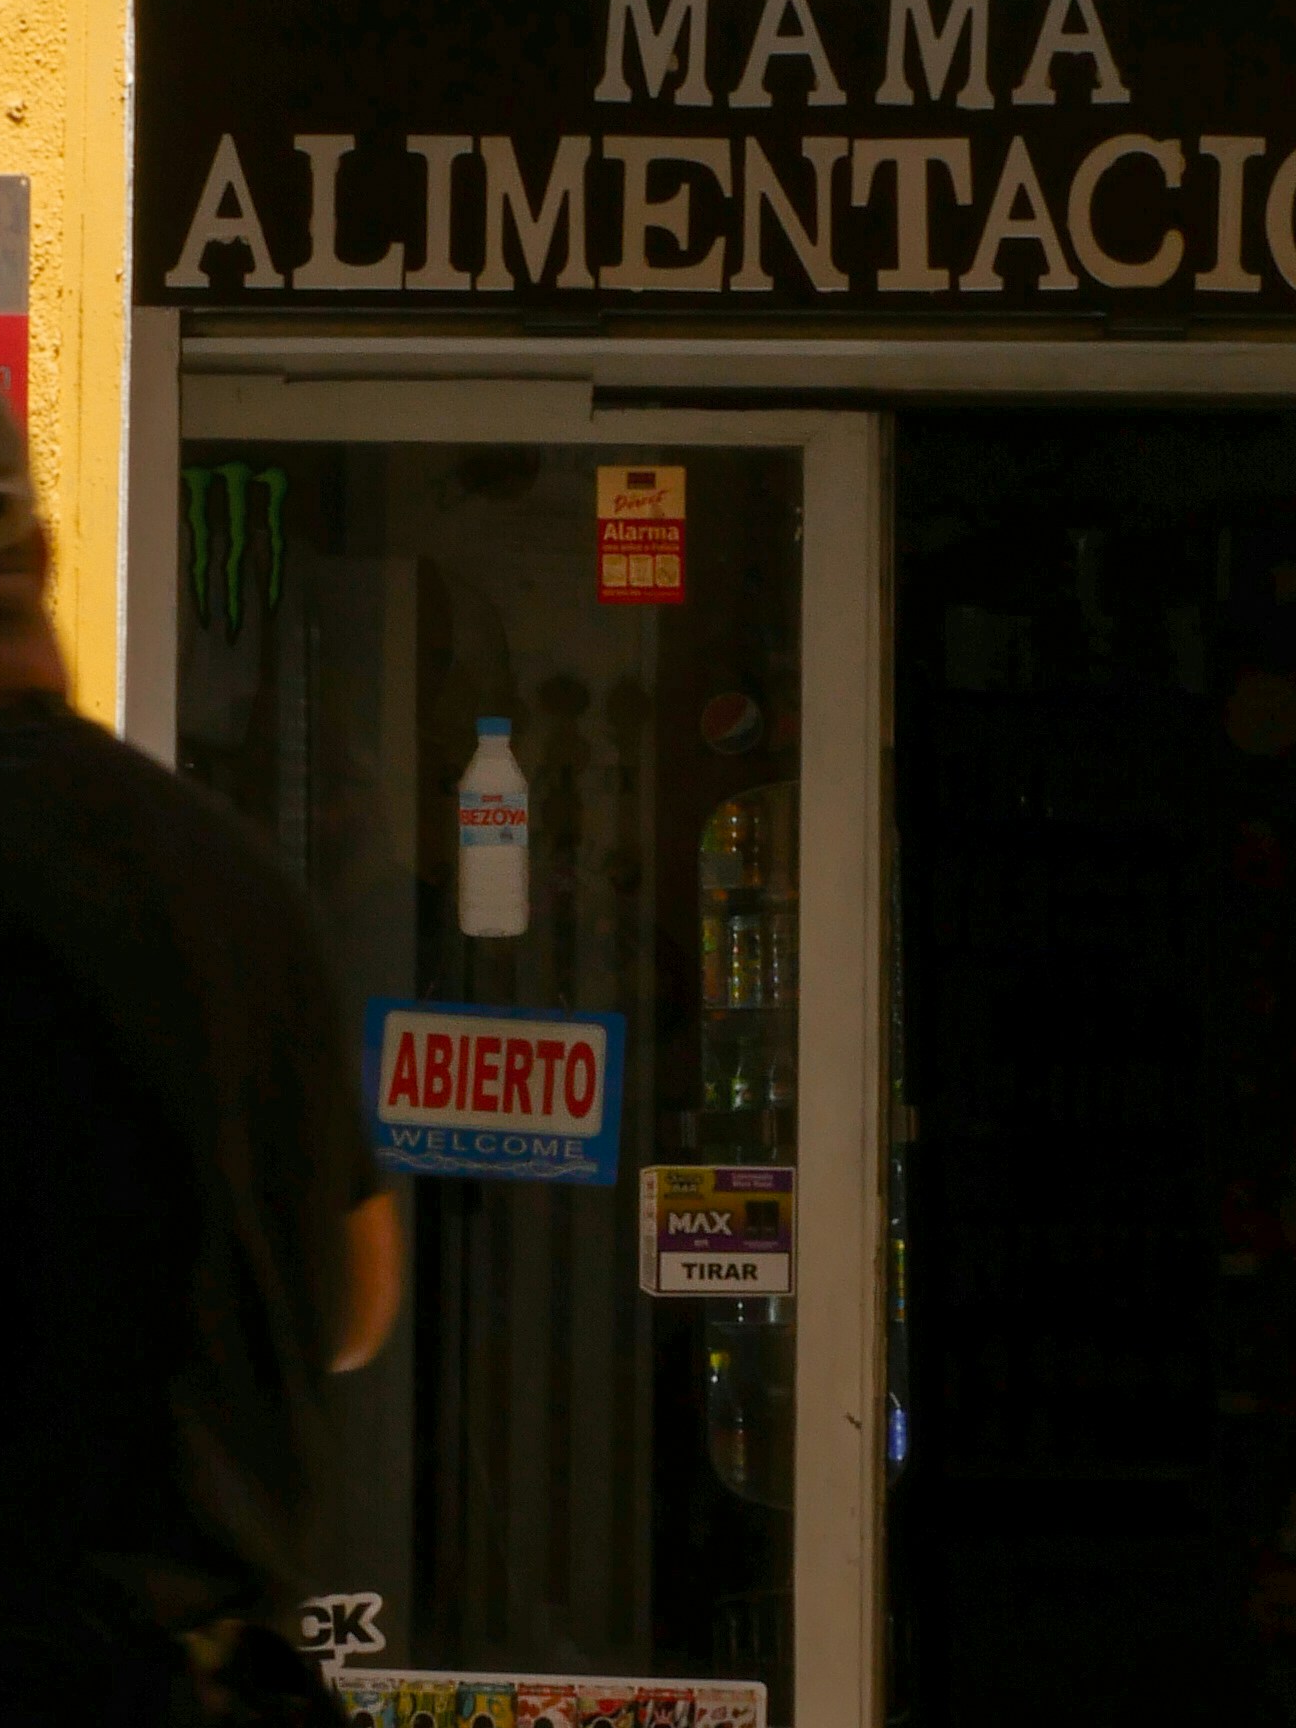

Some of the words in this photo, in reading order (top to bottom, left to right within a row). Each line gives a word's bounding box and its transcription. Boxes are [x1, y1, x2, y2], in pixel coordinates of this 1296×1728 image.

[602, 521, 681, 542] Alarma
[459, 808, 528, 826] BEZOYA
[387, 1031, 597, 1118] ABIERTO
[391, 1127, 584, 1160] WELCOME
[667, 1210, 733, 1236] MAX
[681, 1262, 758, 1281] TIRAR
